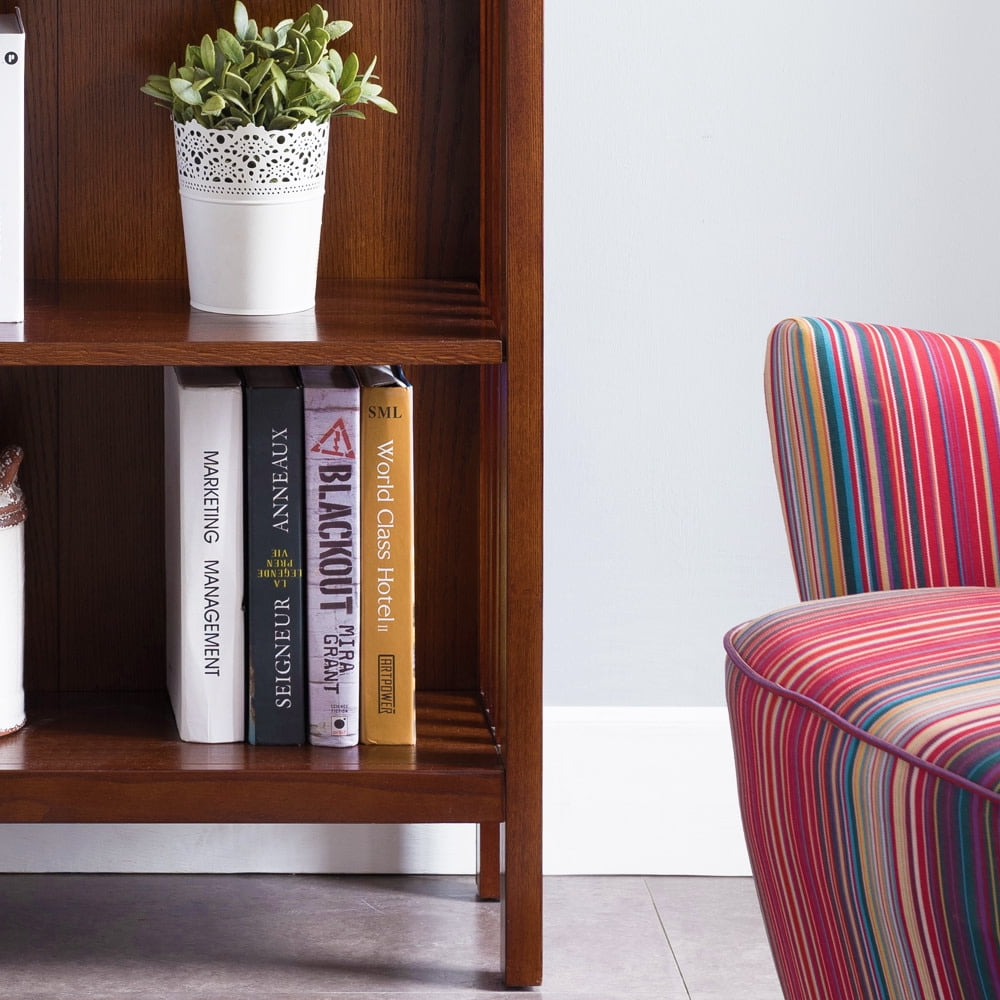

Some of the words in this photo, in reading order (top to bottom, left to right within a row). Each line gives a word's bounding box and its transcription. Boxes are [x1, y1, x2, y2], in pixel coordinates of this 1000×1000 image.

[368, 405, 402, 419] SML
[203, 450, 220, 544] MARKETING
[271, 427, 289, 533] ANNEAUX
[376, 439, 395, 502] World
[271, 549, 288, 557] VIE
[318, 464, 353, 614] BLACKOUT
[376, 508, 395, 560] Class
[257, 567, 303, 577] LEGENDE
[273, 580, 288, 588] LA
[377, 567, 395, 622] Hotel
[203, 560, 220, 677] MANAGEMENT
[273, 597, 292, 709] SEIGNEUR
[323, 634, 340, 695] GRANT
[338, 624, 355, 675] MIRA
[379, 658, 393, 714] ARTPOWER
